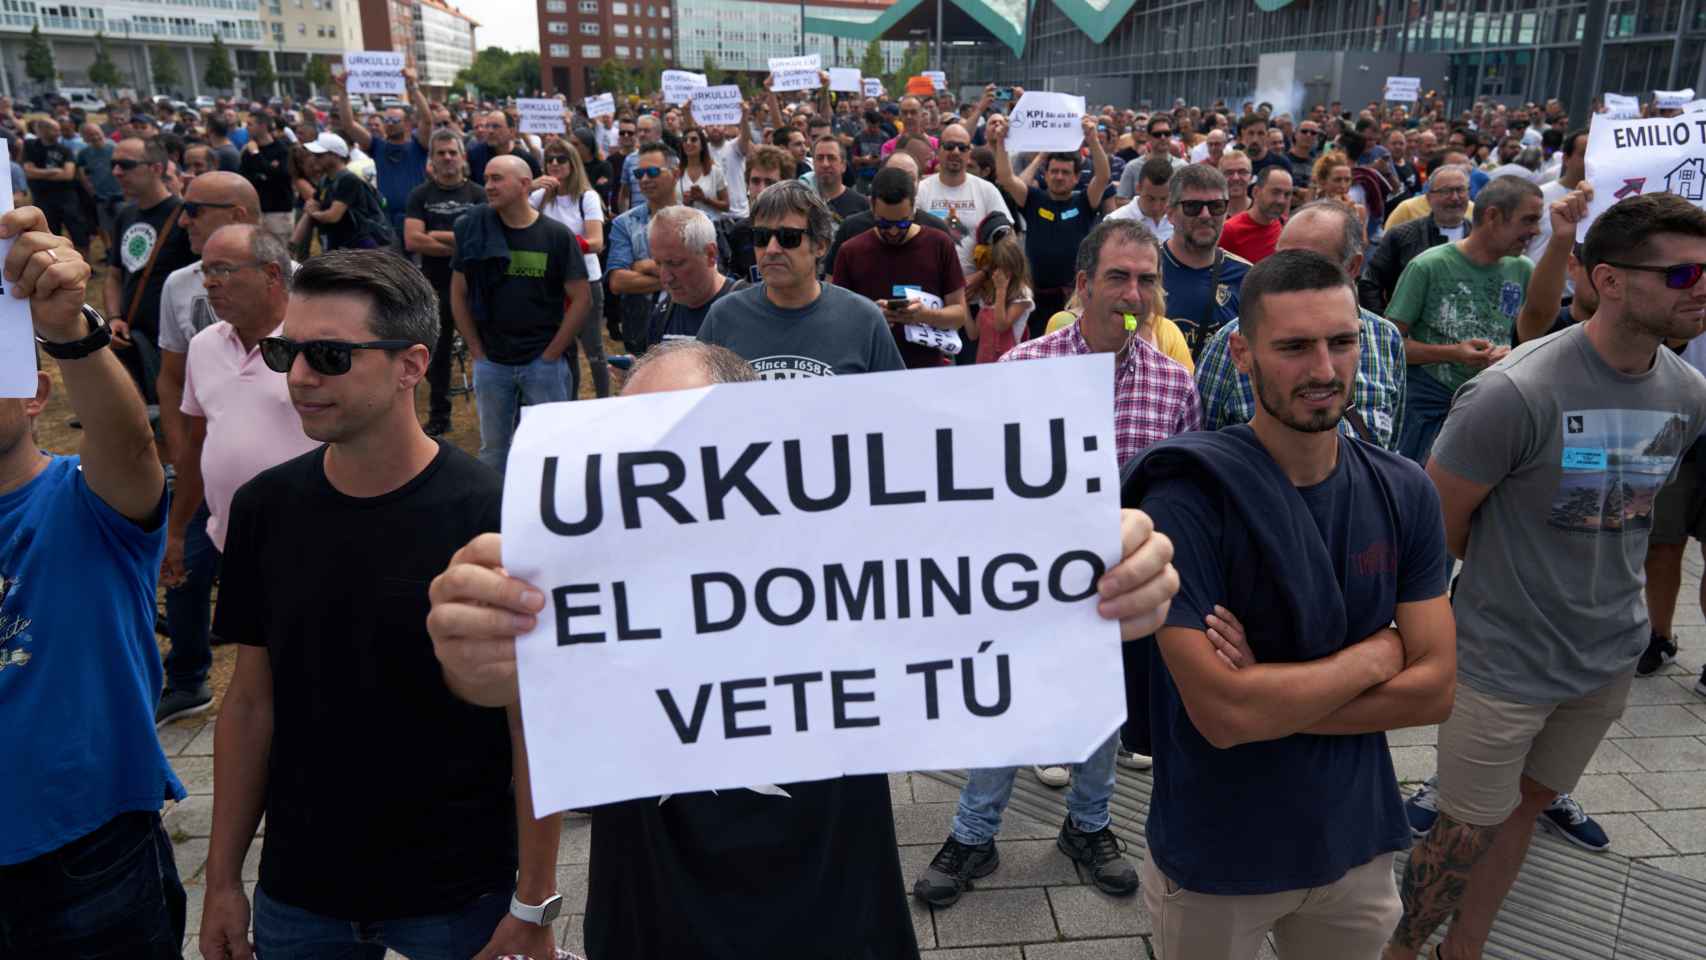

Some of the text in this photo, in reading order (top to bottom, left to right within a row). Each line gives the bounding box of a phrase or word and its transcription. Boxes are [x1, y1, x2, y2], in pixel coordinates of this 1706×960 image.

[702, 114, 722, 122] VETE
[1026, 110, 1043, 119] KPI
[1613, 122, 1690, 149] EMILIO
[754, 359, 822, 375] Since 1658
[540, 418, 1101, 537] URKULLU:
[551, 549, 1107, 647] EL DOMINGO
[655, 640, 1012, 745] VETE TÚ
